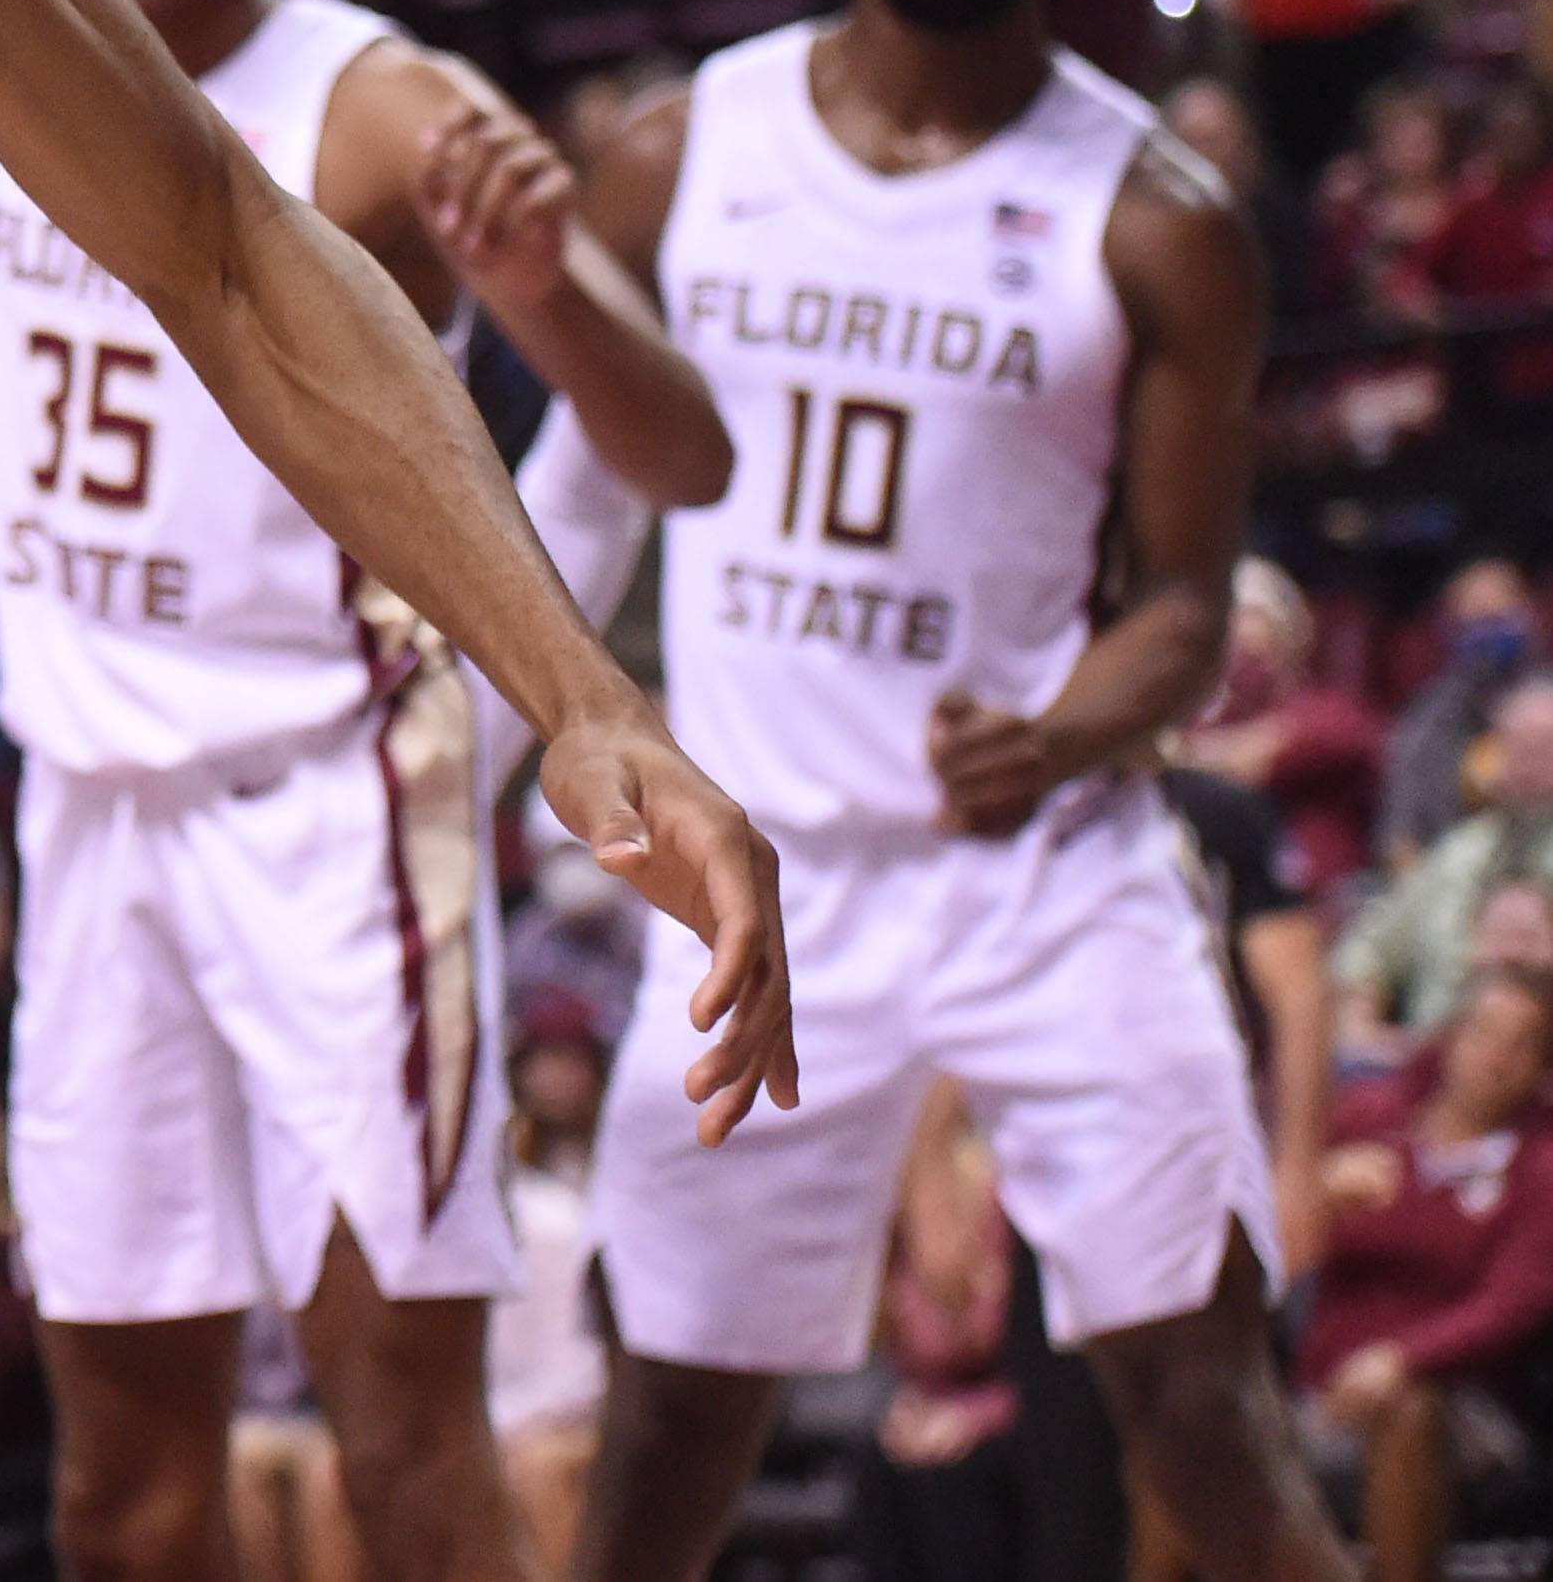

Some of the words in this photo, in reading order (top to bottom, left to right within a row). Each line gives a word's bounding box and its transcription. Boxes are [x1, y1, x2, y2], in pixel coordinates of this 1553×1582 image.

[689, 276, 1042, 395] FLORIDA
[26, 329, 159, 511] 35
[777, 385, 912, 551] 10
[721, 559, 955, 662] STATE
